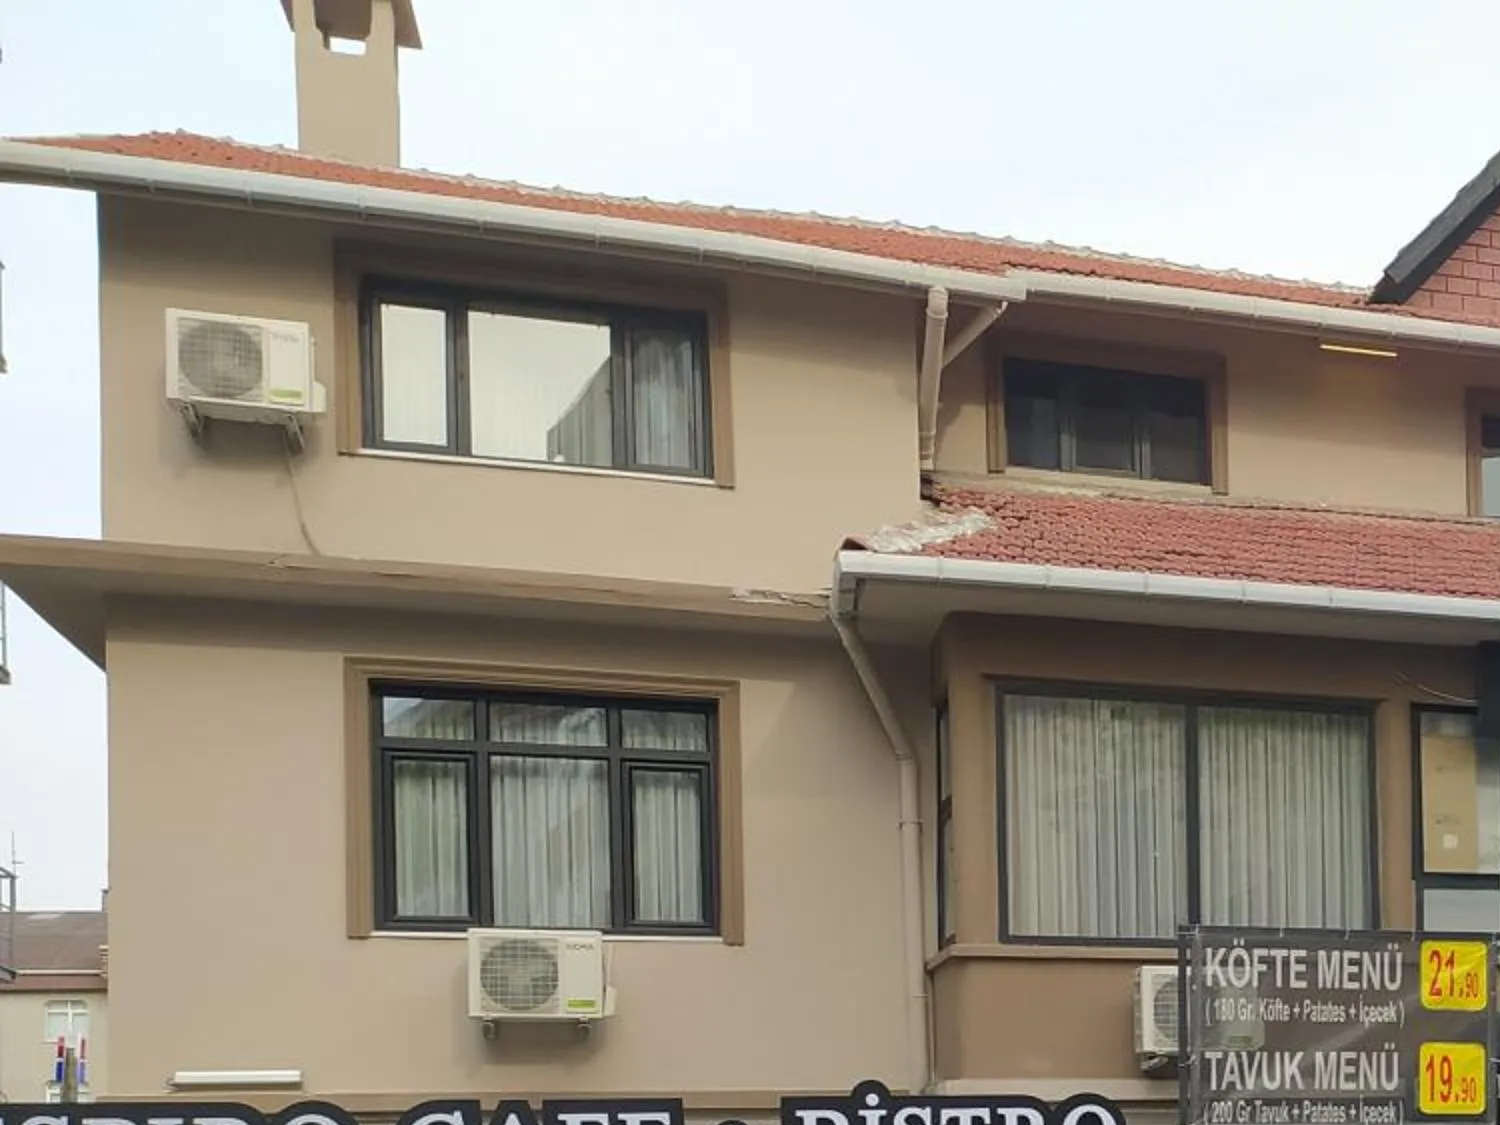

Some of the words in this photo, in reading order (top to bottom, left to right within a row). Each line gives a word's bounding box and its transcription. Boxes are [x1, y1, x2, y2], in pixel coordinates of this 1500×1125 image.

[1205, 937, 1308, 989] KÖFTE
[1317, 943, 1403, 991] MENÜ
[1258, 997, 1291, 1022] Köfte
[1303, 999, 1346, 1023] Patates
[1204, 1051, 1304, 1091] TAVUK
[1314, 1043, 1400, 1091] MENÜ
[1254, 1099, 1290, 1123] Tavuk
[1303, 1100, 1346, 1124] Patates
